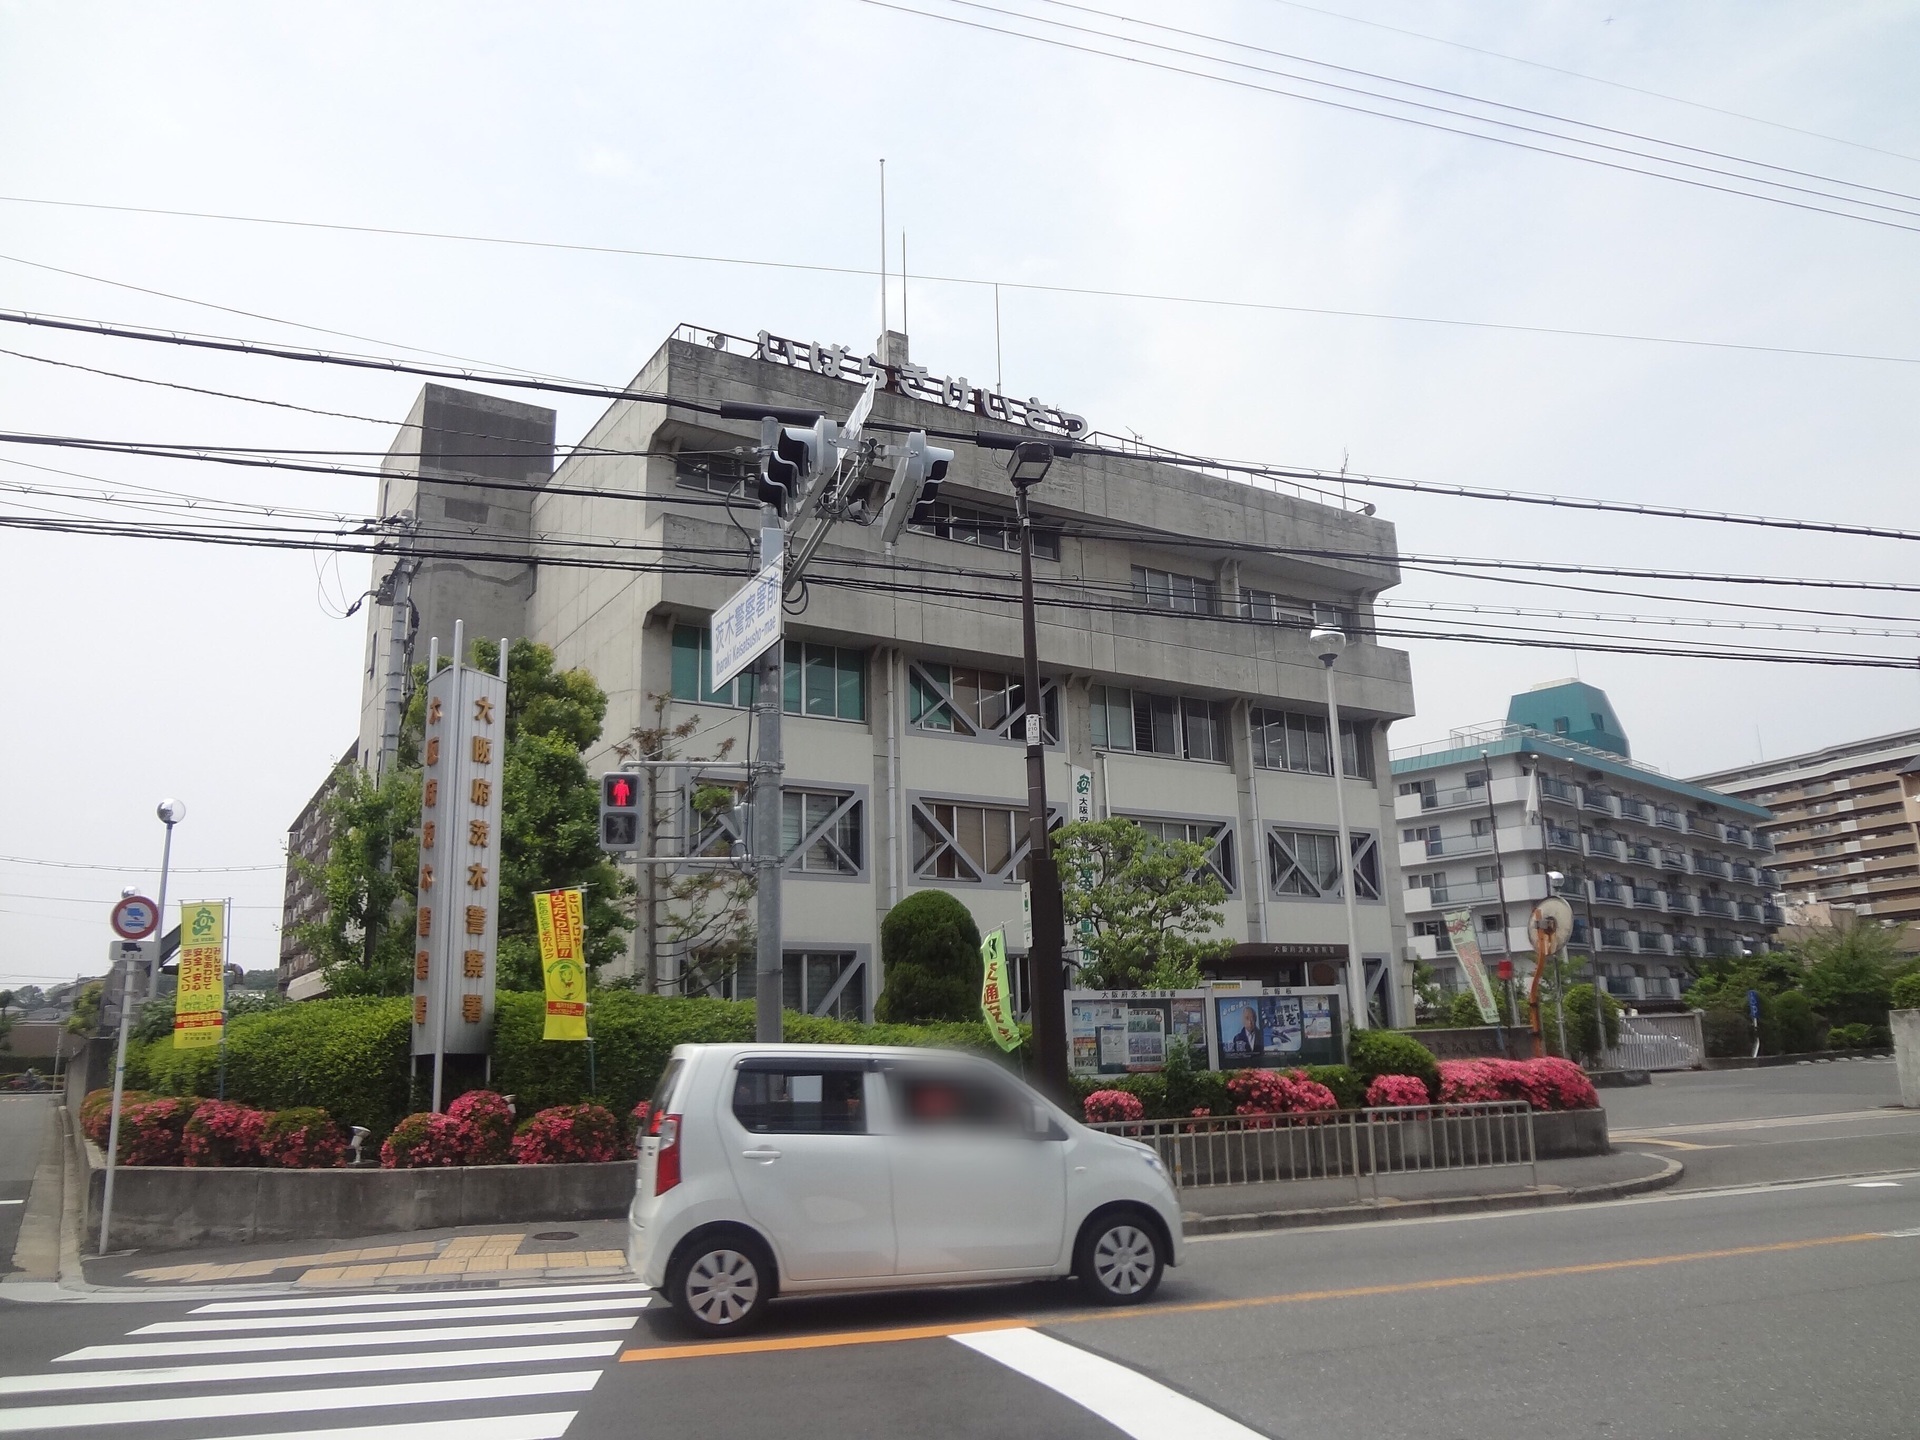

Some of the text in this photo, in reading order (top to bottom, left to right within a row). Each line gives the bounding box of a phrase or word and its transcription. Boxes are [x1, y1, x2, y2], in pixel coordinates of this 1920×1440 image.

[757, 330, 1088, 440] いばらきけいさつ
[715, 571, 779, 654] 茨木警察署前
[716, 615, 776, 676] Ibaraki Keisatsusho-mae
[413, 696, 443, 1025] 大阪府茨木警察署
[462, 696, 494, 1024] 大阪府茨木警察署
[192, 947, 202, 991] 安全・安心
[203, 947, 213, 990] 力をあわせて
[213, 947, 221, 981] みんなで
[1101, 990, 1176, 999] 大阪府茨木警察署
